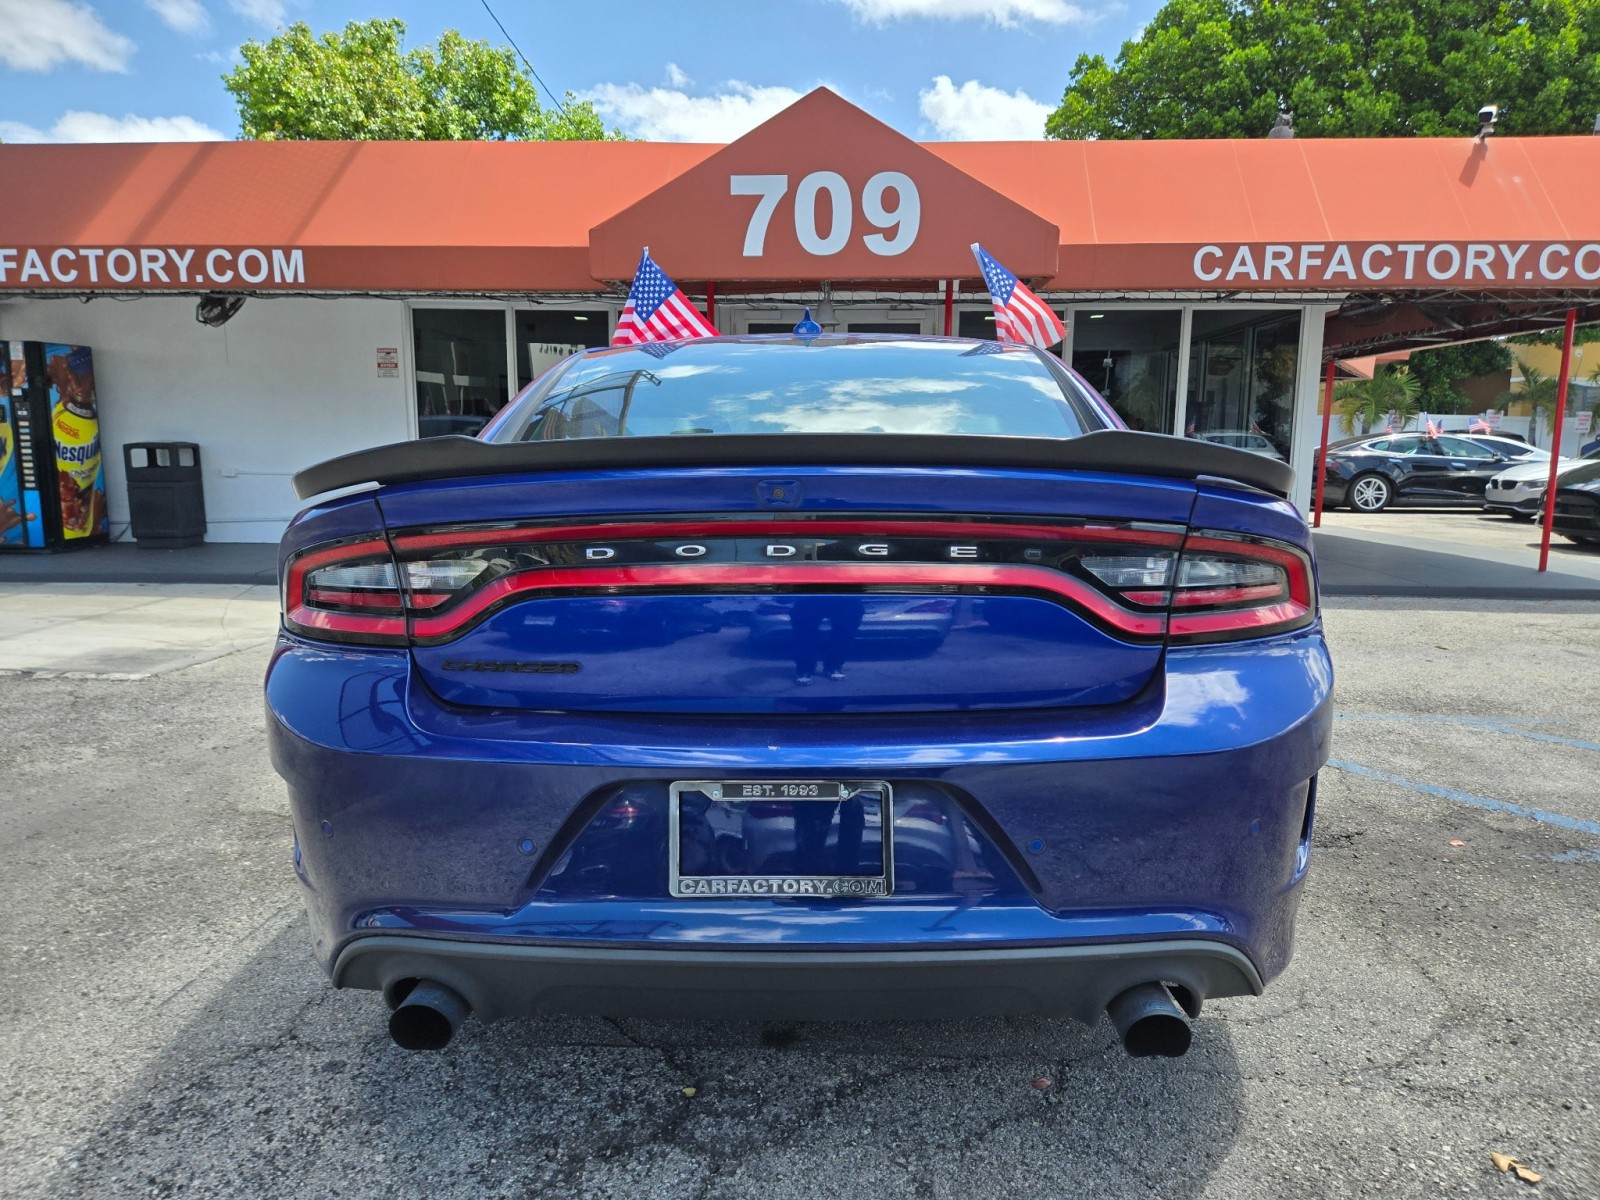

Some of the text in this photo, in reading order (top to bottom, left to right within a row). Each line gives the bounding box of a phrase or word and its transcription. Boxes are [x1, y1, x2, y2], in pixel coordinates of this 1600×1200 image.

[730, 171, 921, 257] 709
[0, 248, 305, 283] FACTORY.COM
[1193, 243, 1600, 281] CARFACTORY.CO
[586, 543, 978, 560] DODGE
[442, 659, 581, 673] CHARGER
[742, 785, 819, 796] EST. 1993
[680, 879, 884, 894] CARFACTORY.COM
